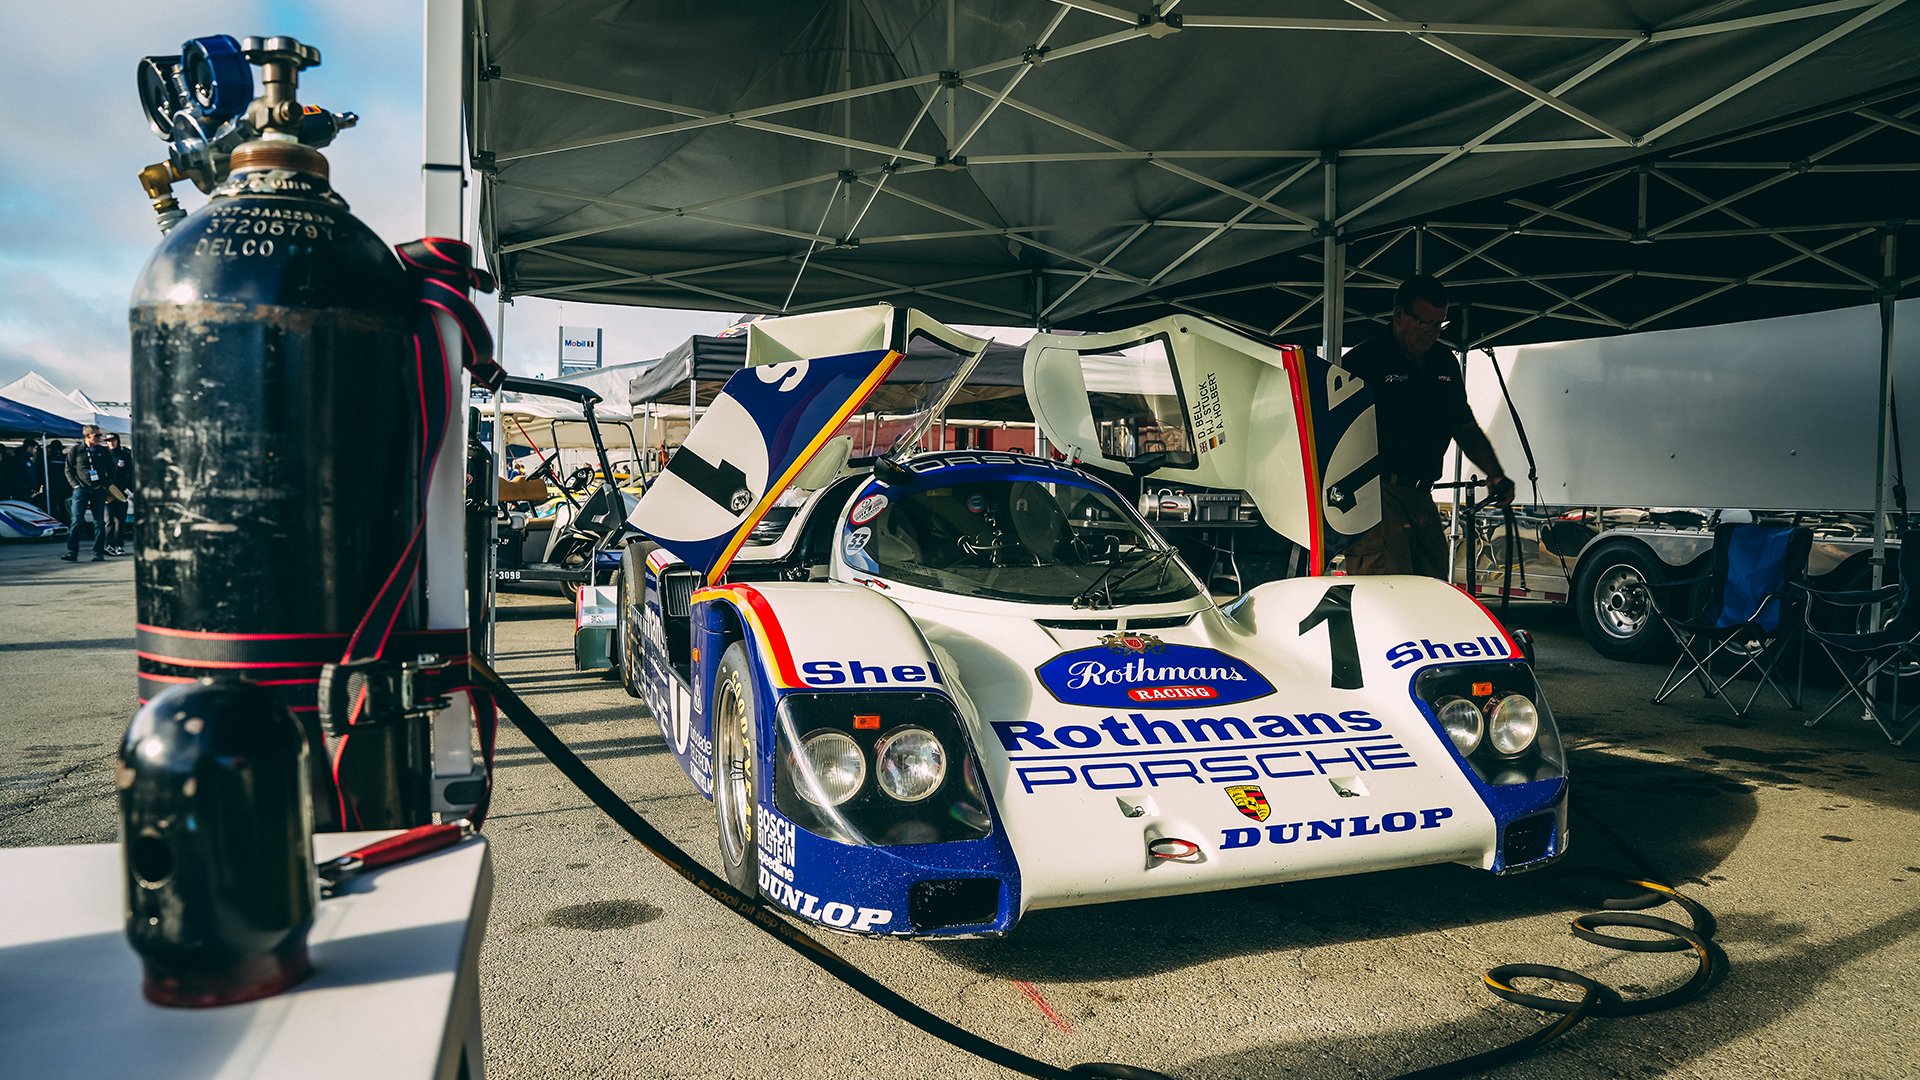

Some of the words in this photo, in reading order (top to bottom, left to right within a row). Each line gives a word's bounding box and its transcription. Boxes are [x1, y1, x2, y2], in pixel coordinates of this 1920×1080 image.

[565, 339, 586, 347] Mobil
[1193, 401, 1204, 427] BELL
[1198, 381, 1212, 416] STUCK
[1207, 372, 1222, 419] HOLBERT
[1197, 428, 1206, 439] D.
[848, 533, 869, 549] 33
[1299, 584, 1364, 690] 1
[1386, 636, 1509, 669] Shell
[1067, 658, 1247, 690] Rothmans
[1135, 686, 1211, 700] RACING
[989, 709, 1383, 751] Rothmans
[1015, 743, 1419, 794] PORSCHE
[758, 803, 796, 848] BOSCH
[1219, 807, 1454, 851] DUNLOP
[758, 824, 796, 868] BILSTEIN
[758, 865, 893, 931] DUNLOP
